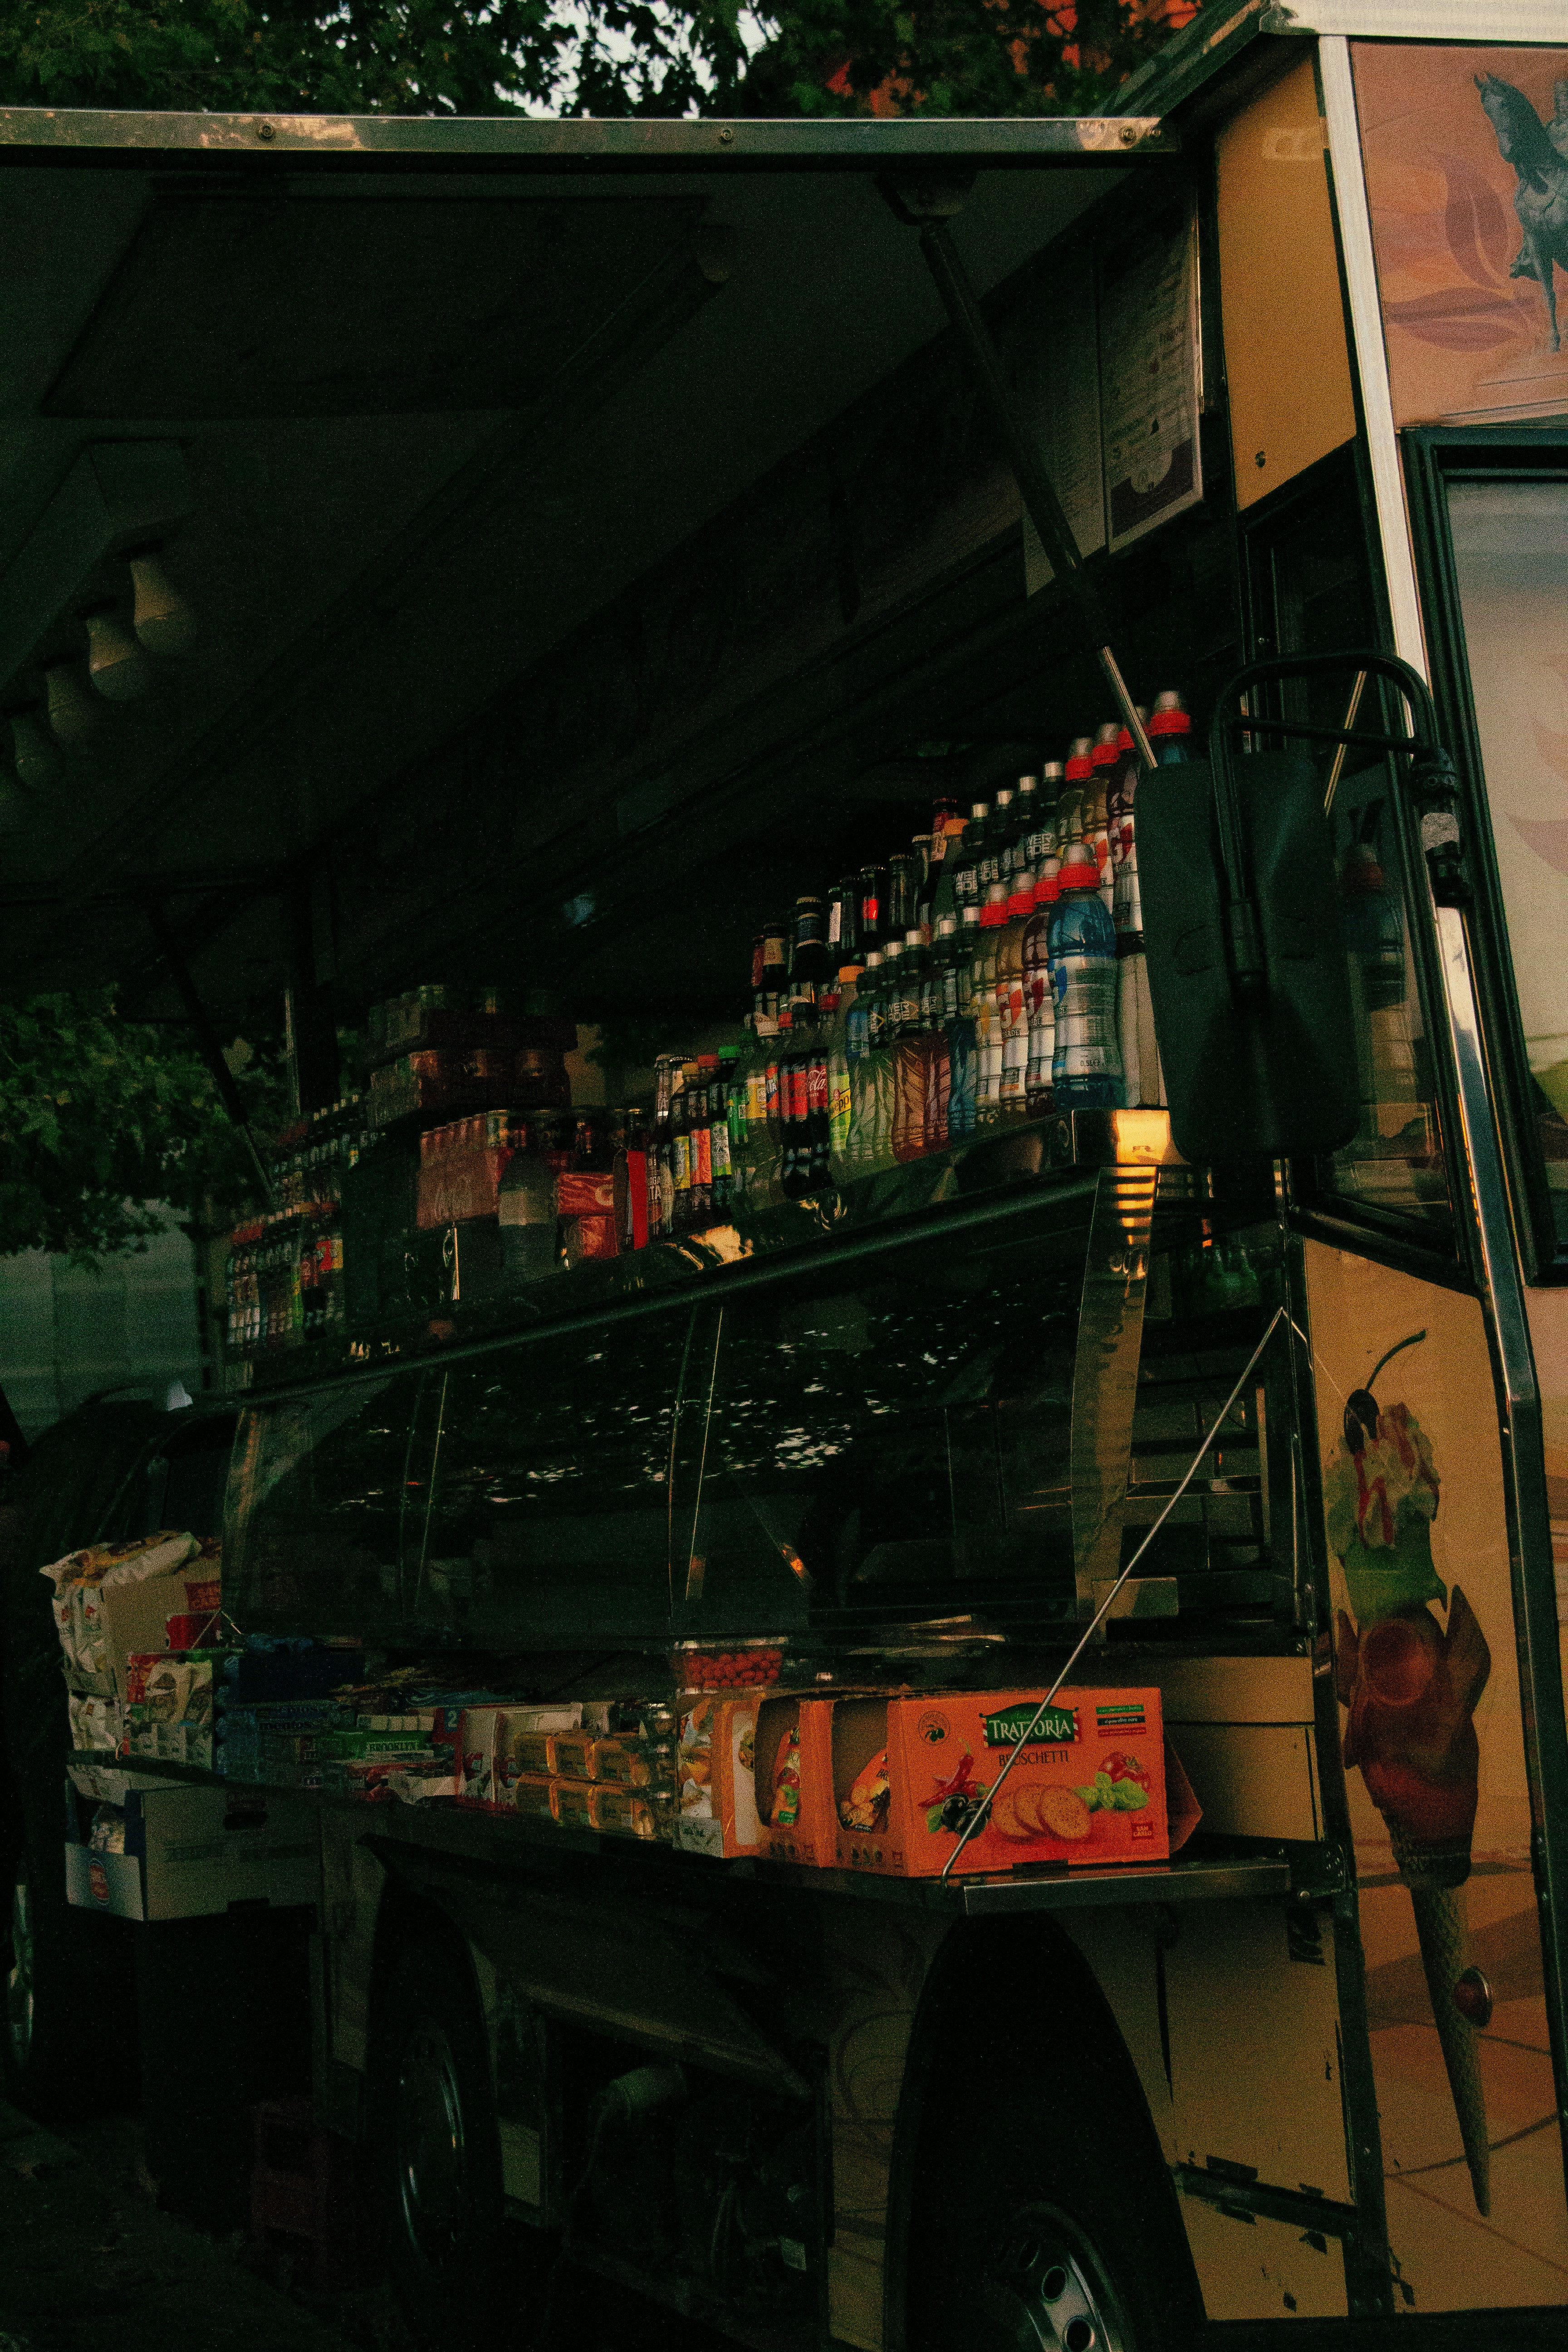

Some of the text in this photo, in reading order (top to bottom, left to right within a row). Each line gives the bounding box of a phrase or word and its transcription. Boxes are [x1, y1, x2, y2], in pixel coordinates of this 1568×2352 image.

[448, 1710, 457, 1728] 2
[259, 1721, 313, 1730] mentos
[369, 1742, 415, 1751] BROOKLYN
